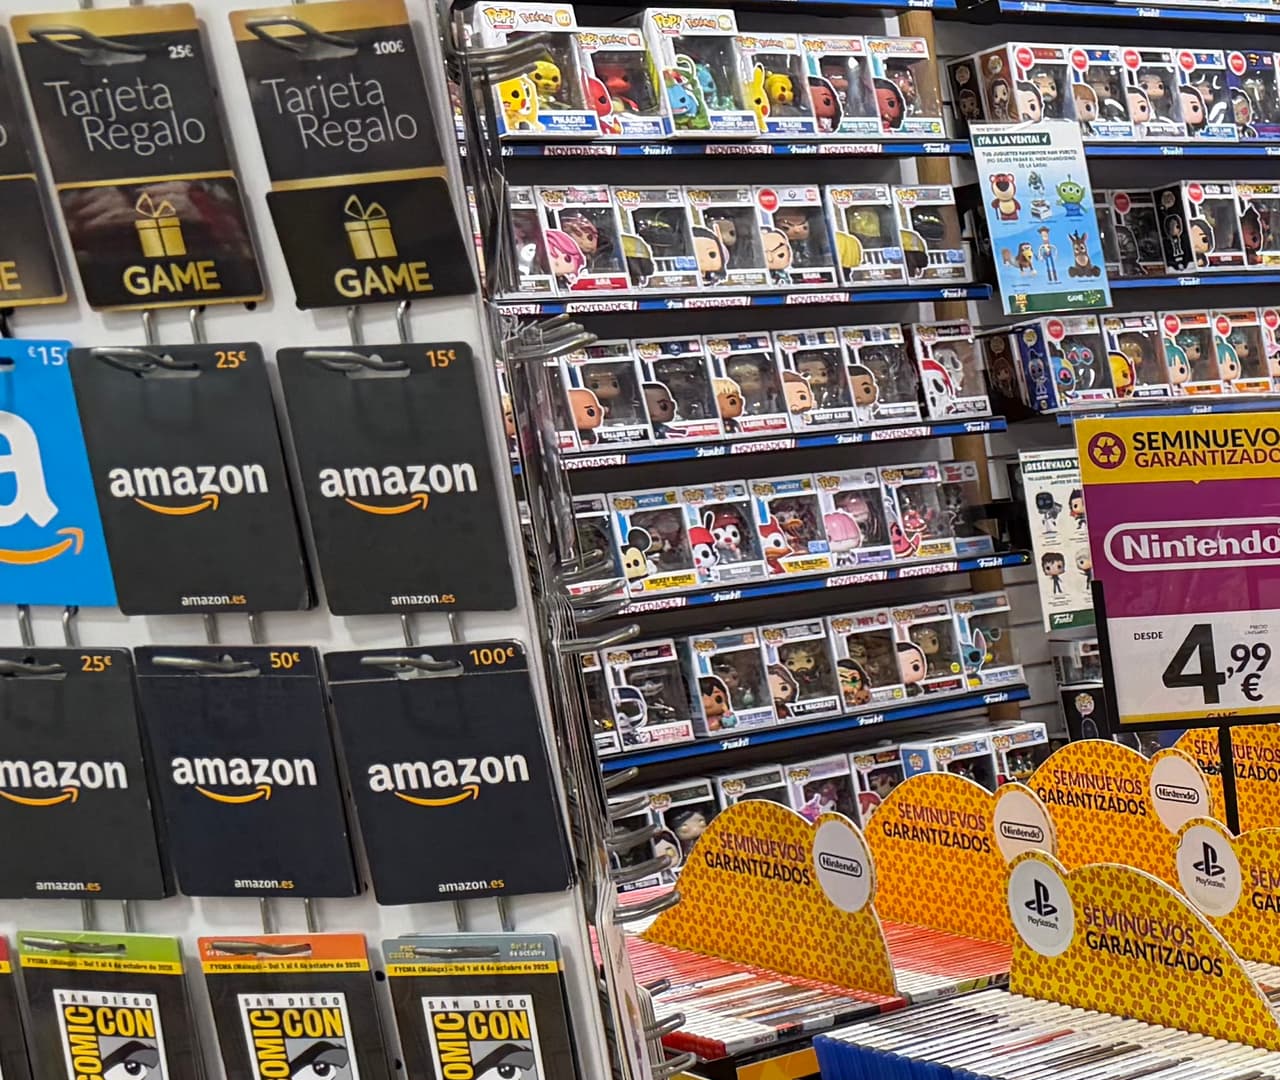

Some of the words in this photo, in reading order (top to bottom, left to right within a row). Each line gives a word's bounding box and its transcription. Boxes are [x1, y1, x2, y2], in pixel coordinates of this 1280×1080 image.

[169, 45, 193, 58] 25€
[44, 79, 173, 121] Tarjeta
[83, 116, 205, 155] Regalo
[123, 262, 220, 294] GAME
[216, 352, 246, 368] 25€
[109, 463, 268, 497] amazon
[1134, 631, 1163, 641] DESDE
[470, 648, 514, 665] 100€
[1241, 674, 1263, 702] €
[368, 754, 529, 793] amazon
[822, 857, 860, 875] Nintendo
[438, 878, 504, 893] amazon.es
[1083, 906, 1195, 947] SEMINUEVOS
[1085, 932, 1224, 977] GARANTIZADOS
[428, 1001, 459, 1009] SAN
[475, 1000, 526, 1009] DIEGO
[468, 1012, 529, 1040] CON
